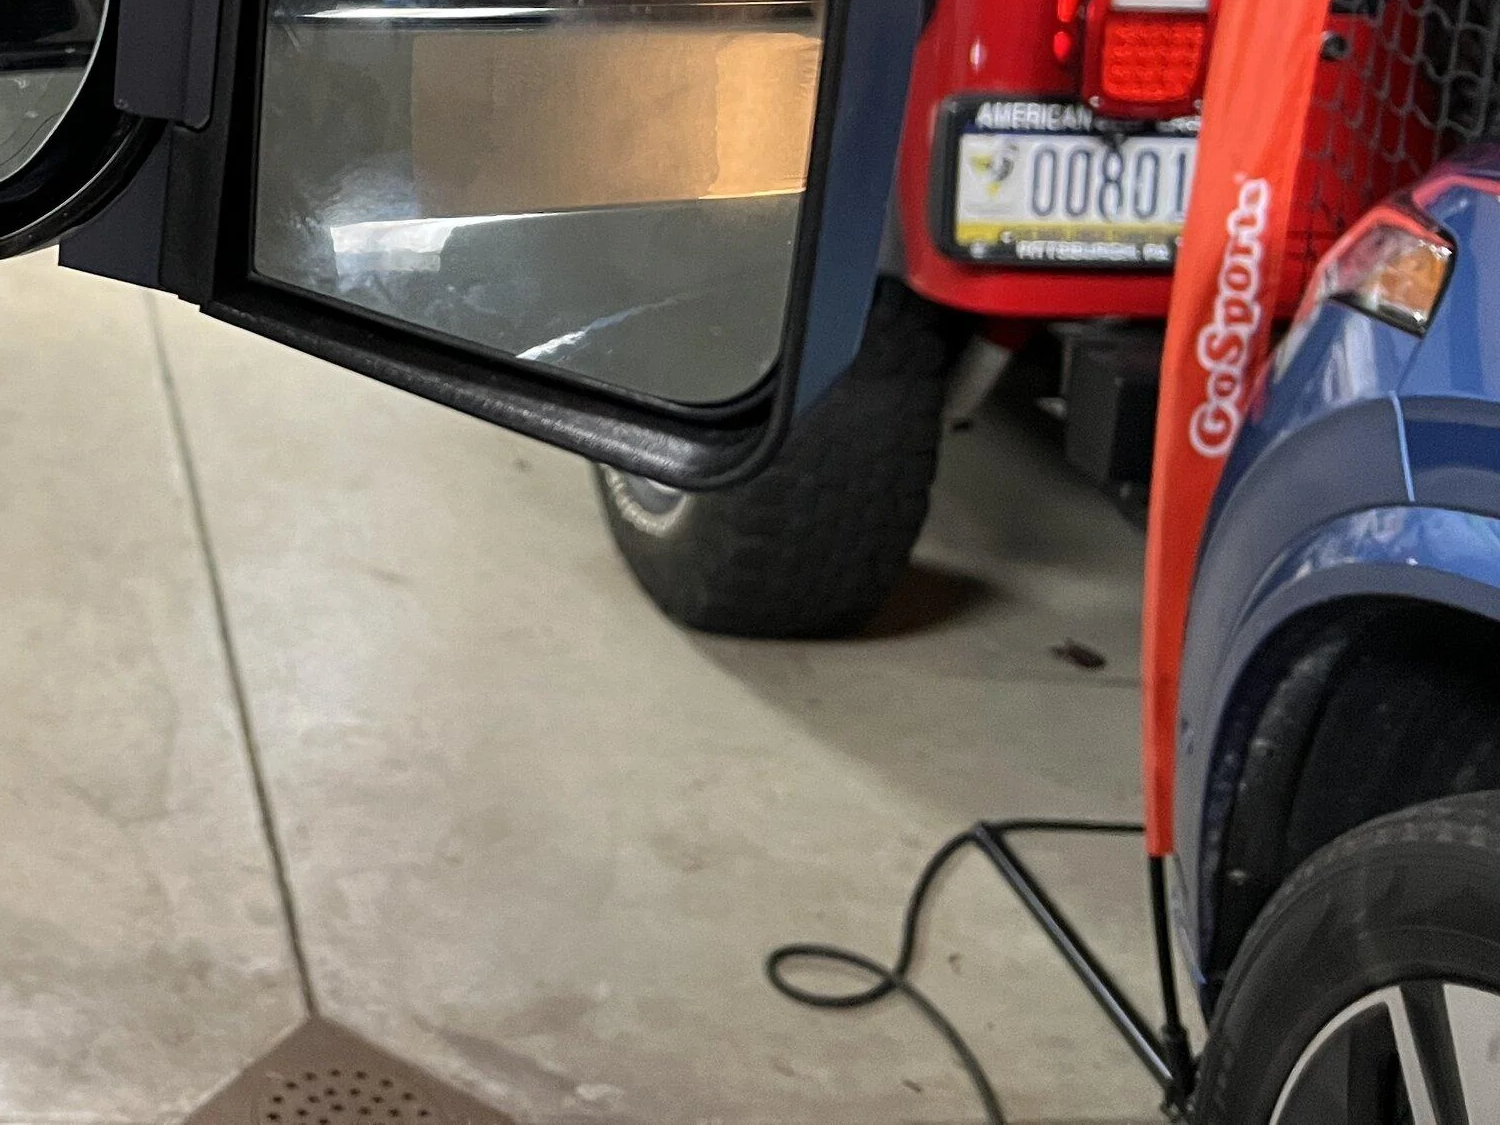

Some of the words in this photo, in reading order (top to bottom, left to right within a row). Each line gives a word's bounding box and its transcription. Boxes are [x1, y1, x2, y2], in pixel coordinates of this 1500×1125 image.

[975, 101, 1093, 132] AMERICAN
[1031, 145, 1192, 223] 00801
[1189, 177, 1271, 458] GoSports
